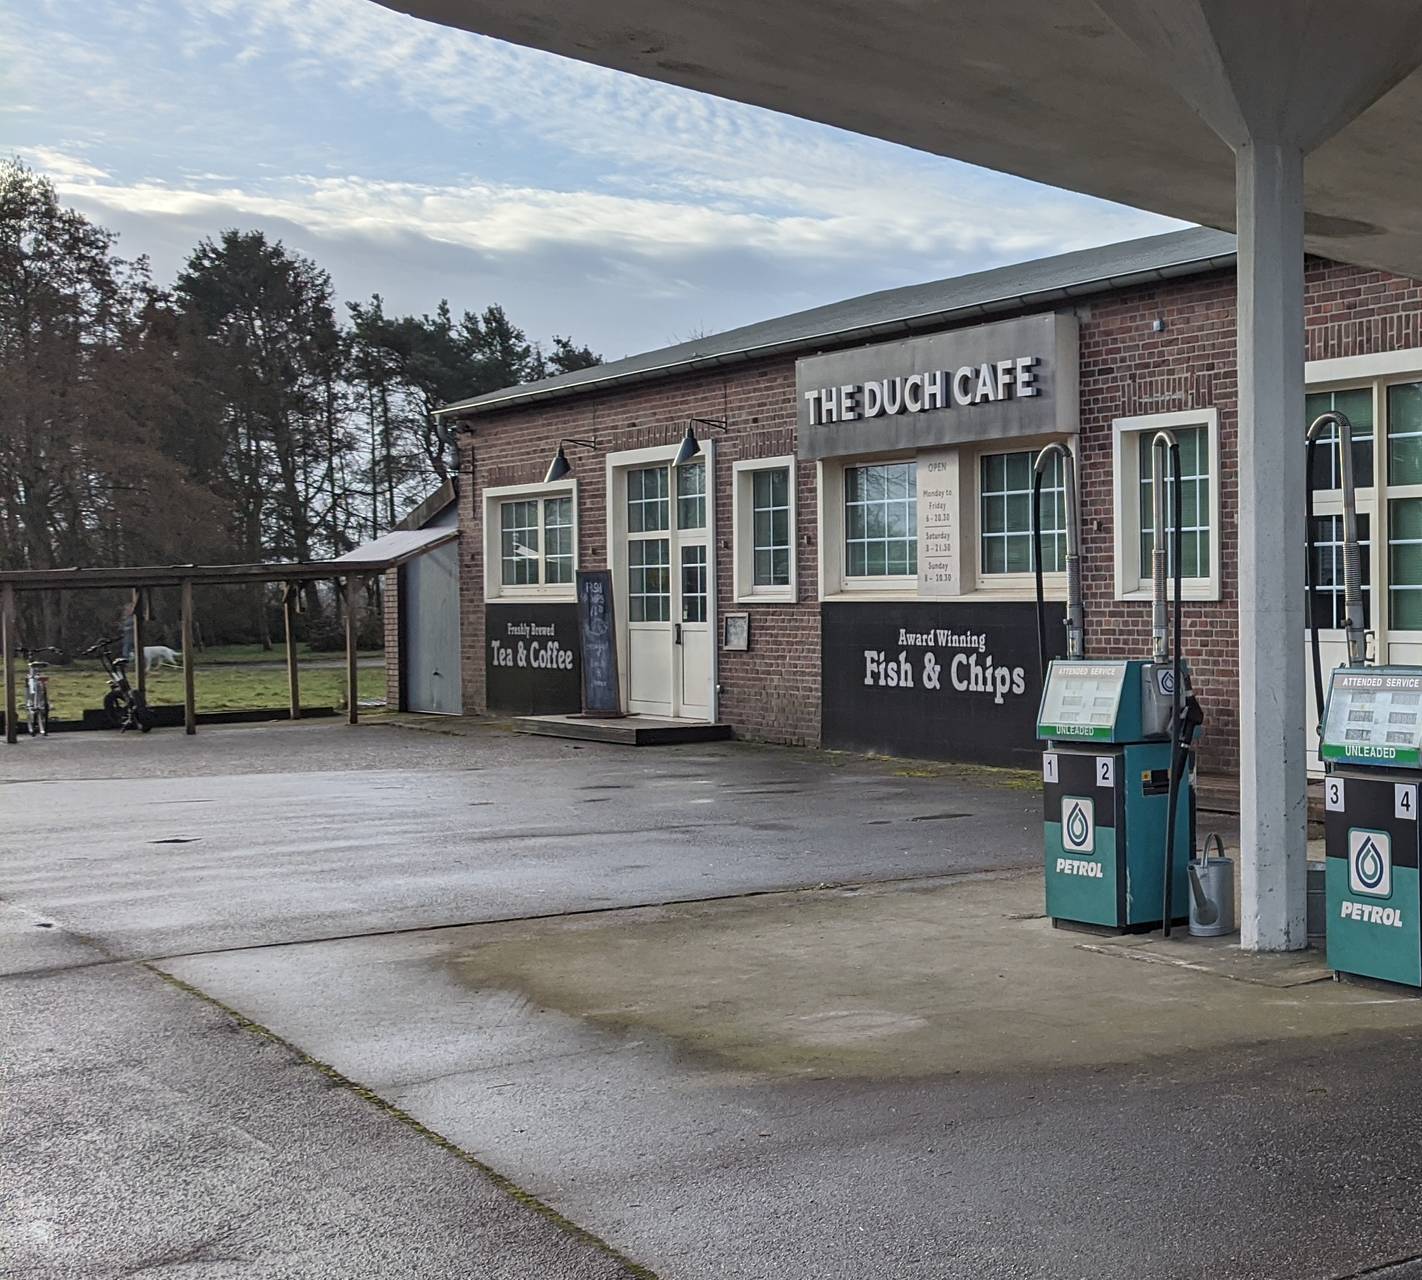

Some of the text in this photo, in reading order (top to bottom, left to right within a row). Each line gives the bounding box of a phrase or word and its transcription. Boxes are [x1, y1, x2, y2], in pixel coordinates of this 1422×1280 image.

[804, 356, 1041, 425] THE DUCH CAFE
[928, 462, 947, 472] OPEN
[923, 490, 945, 499] Monday
[928, 502, 946, 511] Friday
[925, 531, 951, 541] Saturday
[928, 561, 949, 572] Sunday
[507, 622, 556, 639] Freshly Brewed
[898, 628, 987, 653] Award Winning
[491, 640, 514, 666] Tea
[517, 640, 527, 668] &
[530, 641, 573, 670] Coffee
[864, 650, 1026, 704] Fish & Chips
[1342, 677, 1420, 688] ATTENDED SERVICE
[1055, 725, 1095, 736] UNLEADED
[1344, 745, 1397, 759] UNLEADED
[1047, 759, 1053, 777] 1
[1101, 762, 1110, 781] 2
[1330, 783, 1339, 805] 3
[1400, 790, 1411, 812] 4
[1055, 858, 1104, 878] PETROL
[1340, 900, 1403, 928] PETROL
